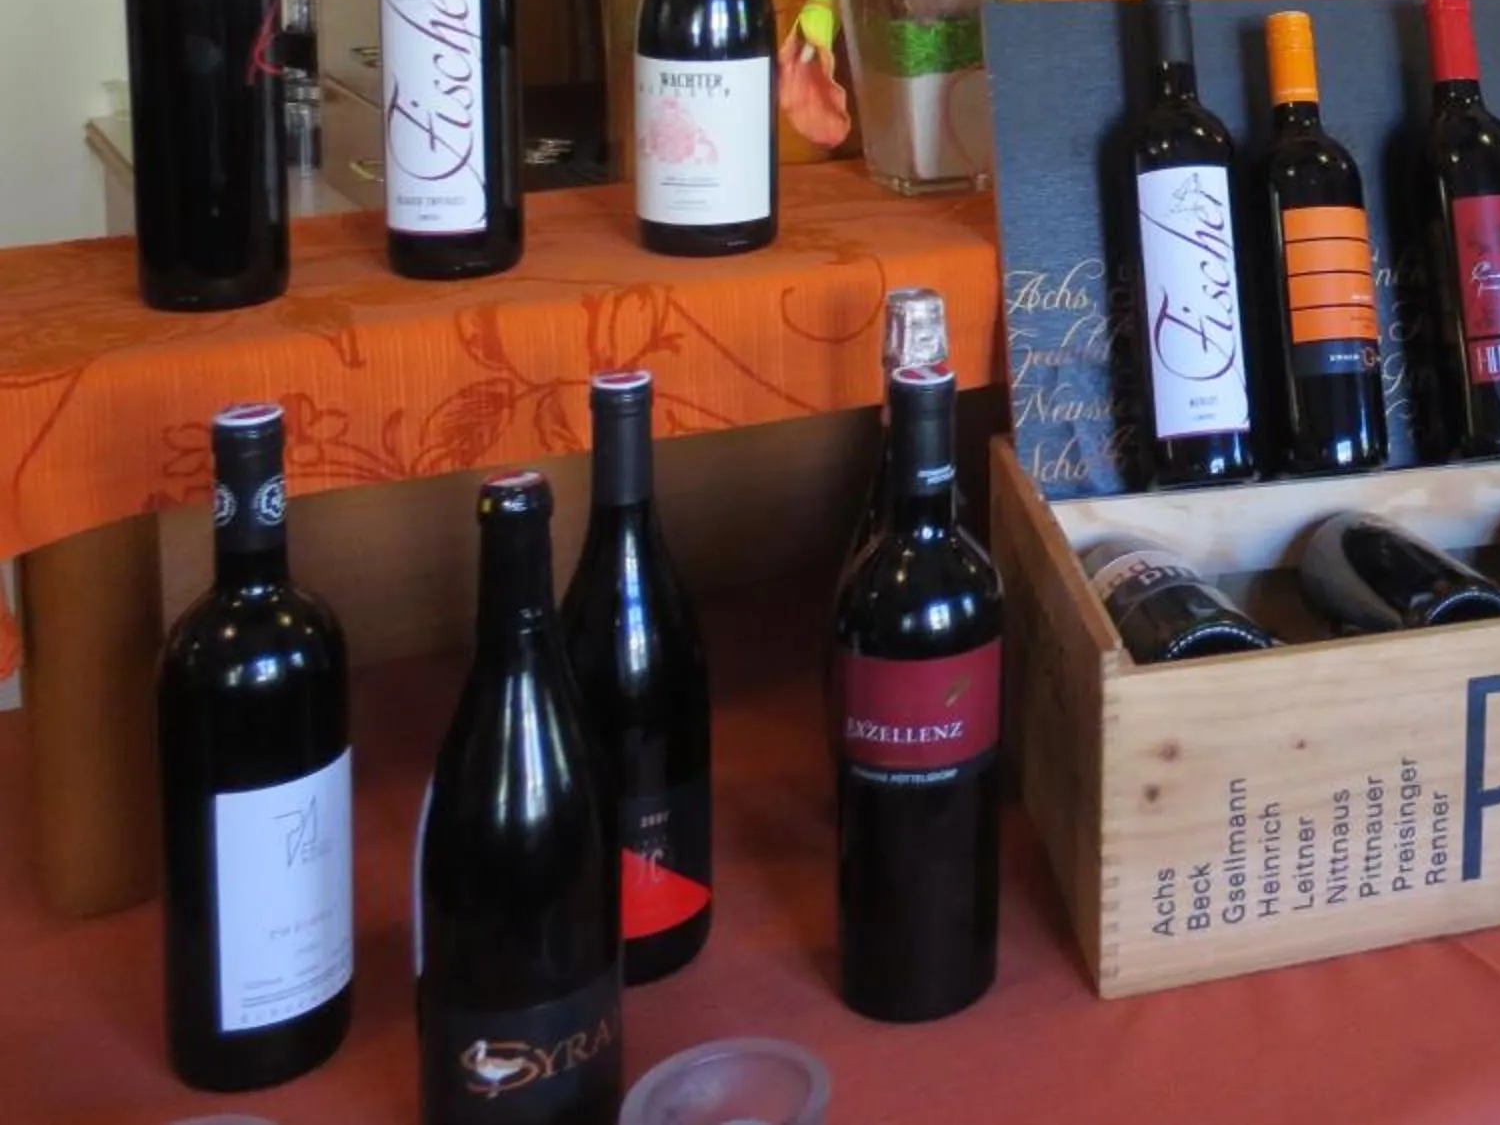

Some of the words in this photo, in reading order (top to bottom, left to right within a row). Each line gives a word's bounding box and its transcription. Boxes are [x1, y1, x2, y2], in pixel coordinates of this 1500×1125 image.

[1222, 778, 1247, 925] Gsellmann
[1258, 802, 1281, 918] Heinrich
[1293, 816, 1316, 911] Leitner
[1326, 788, 1351, 906] Nittnaus
[1359, 776, 1385, 898] Pittnauer
[1391, 756, 1421, 893] Preisinger
[1424, 790, 1449, 886] Renner
[1152, 867, 1176, 937] Achs
[1187, 862, 1212, 931] Beck
[461, 1018, 612, 1099] SYRA
